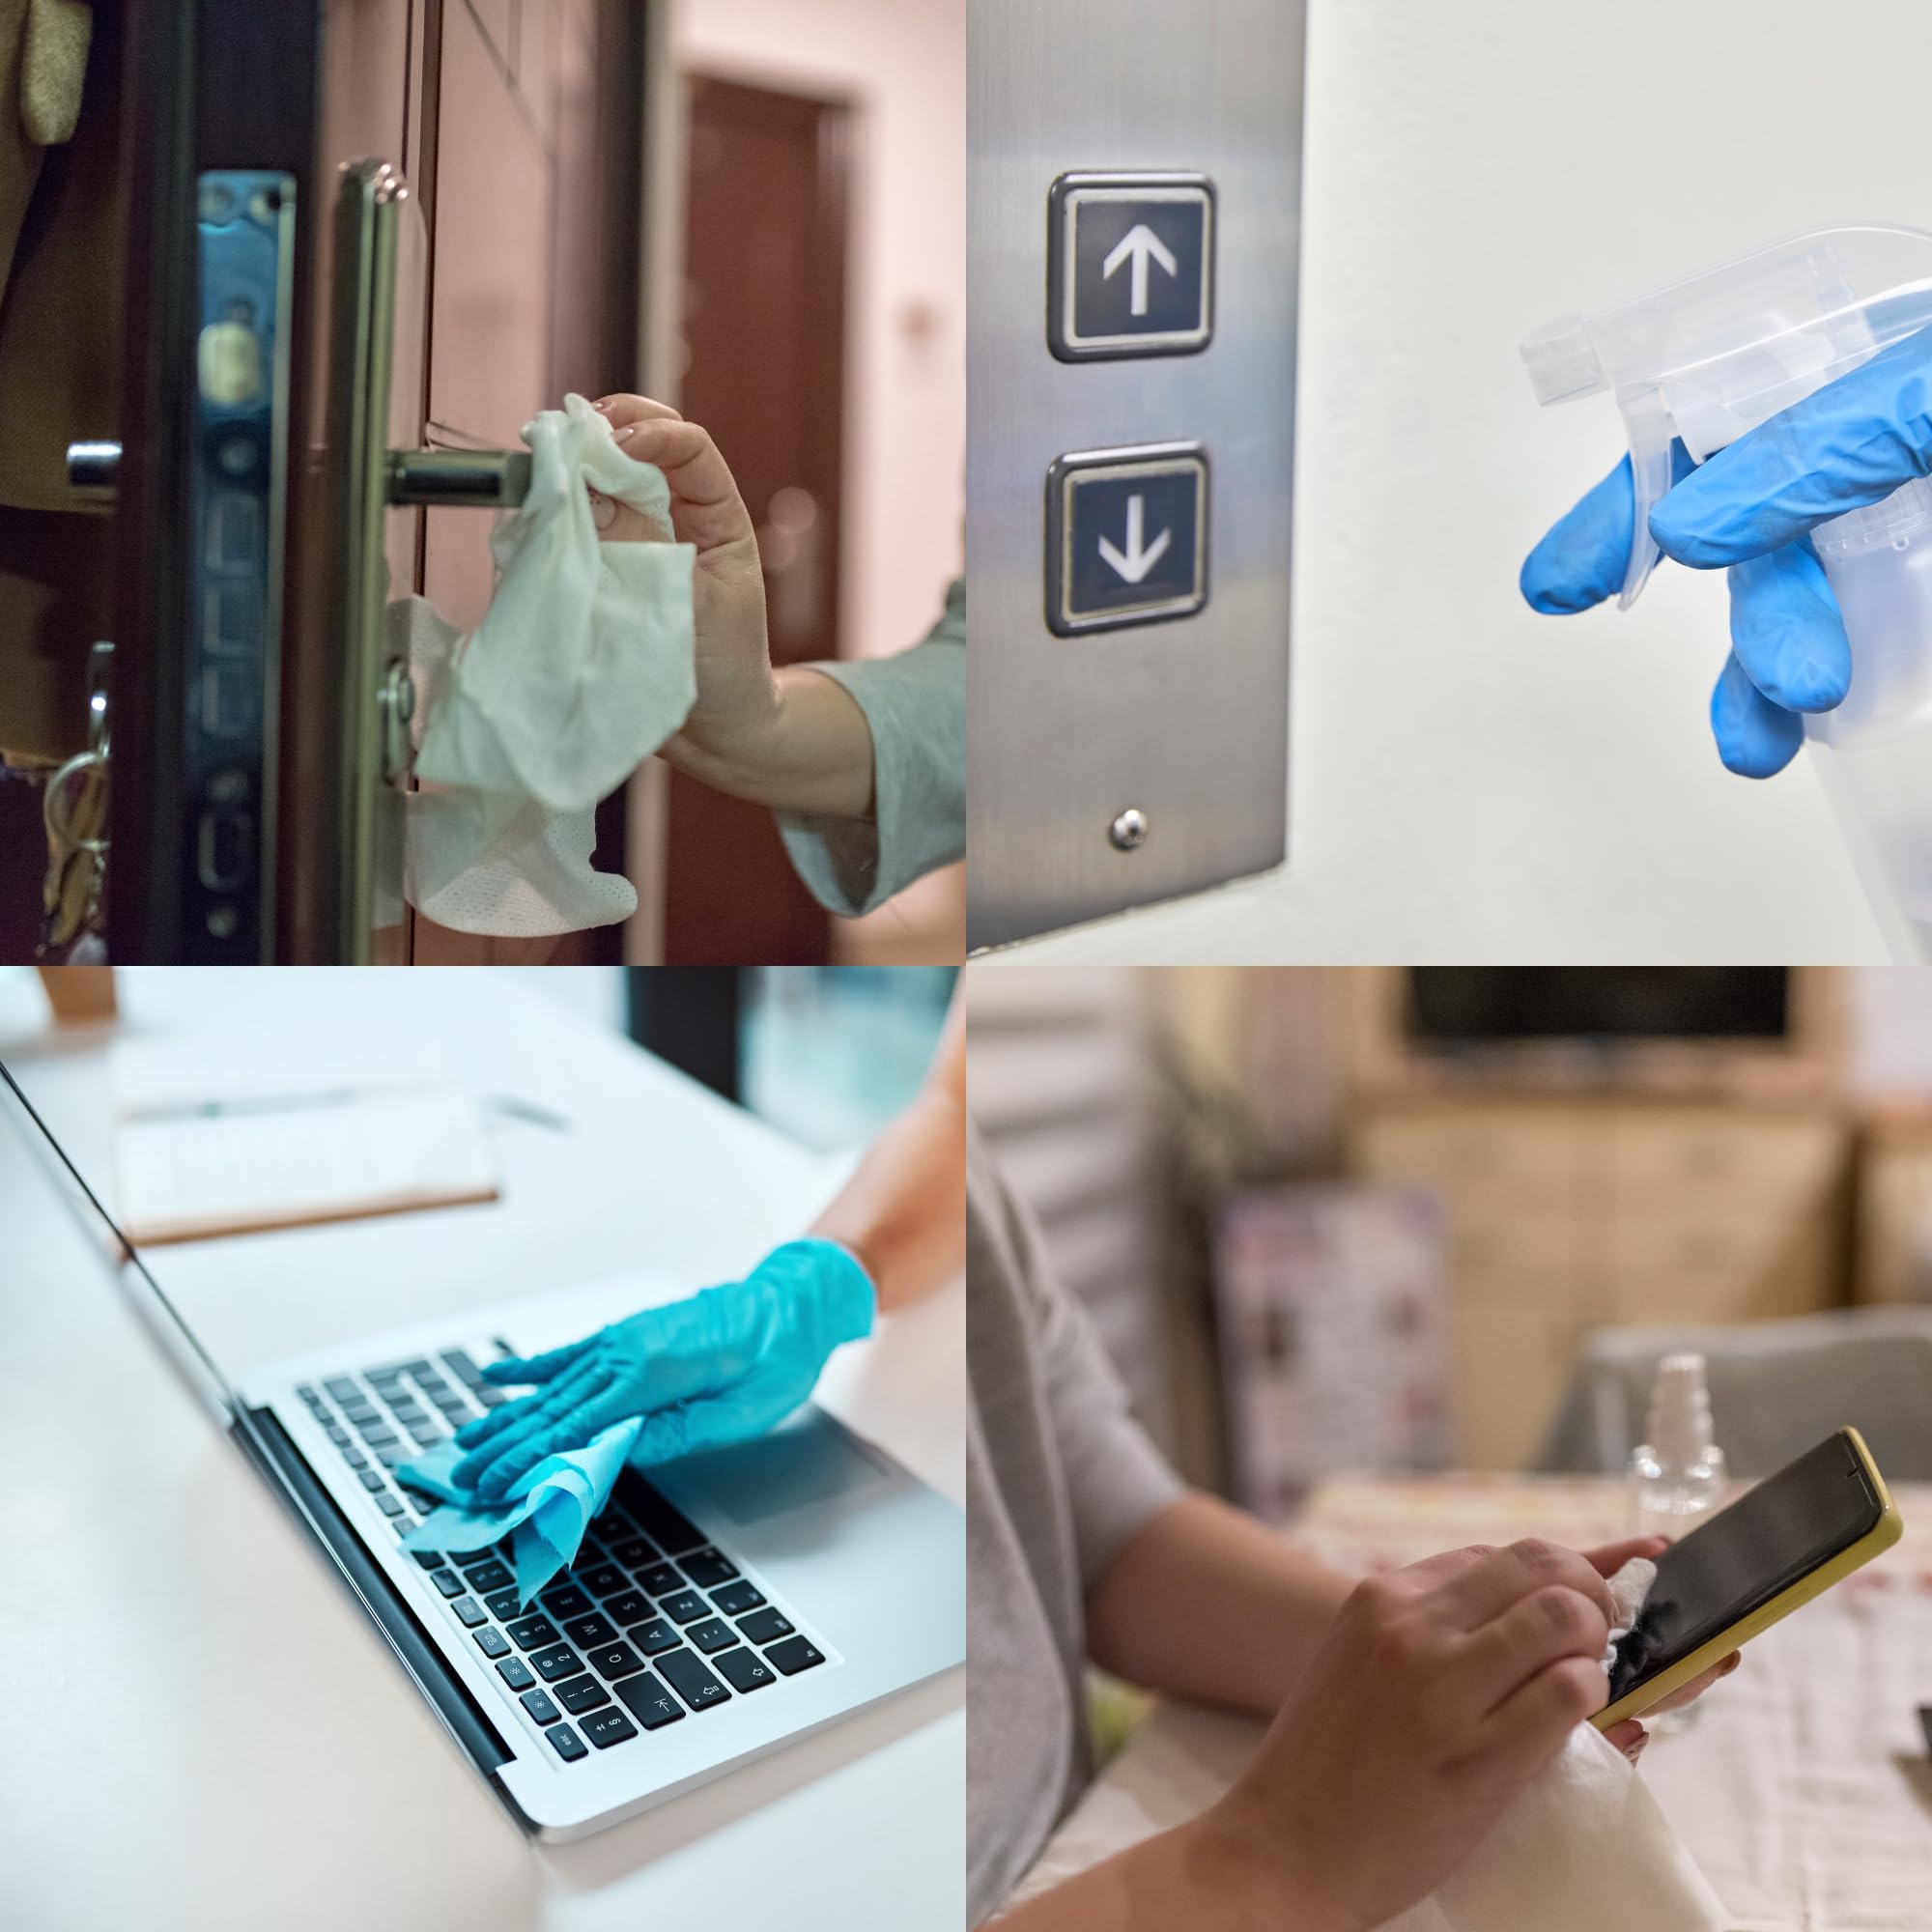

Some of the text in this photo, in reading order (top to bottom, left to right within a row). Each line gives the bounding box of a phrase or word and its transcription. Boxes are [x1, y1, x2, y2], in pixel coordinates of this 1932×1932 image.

[622, 1602, 637, 1611] S
[534, 1624, 547, 1633] 3
[582, 1625, 598, 1635] W
[557, 1653, 571, 1662] 2
[609, 1653, 622, 1663] Q
